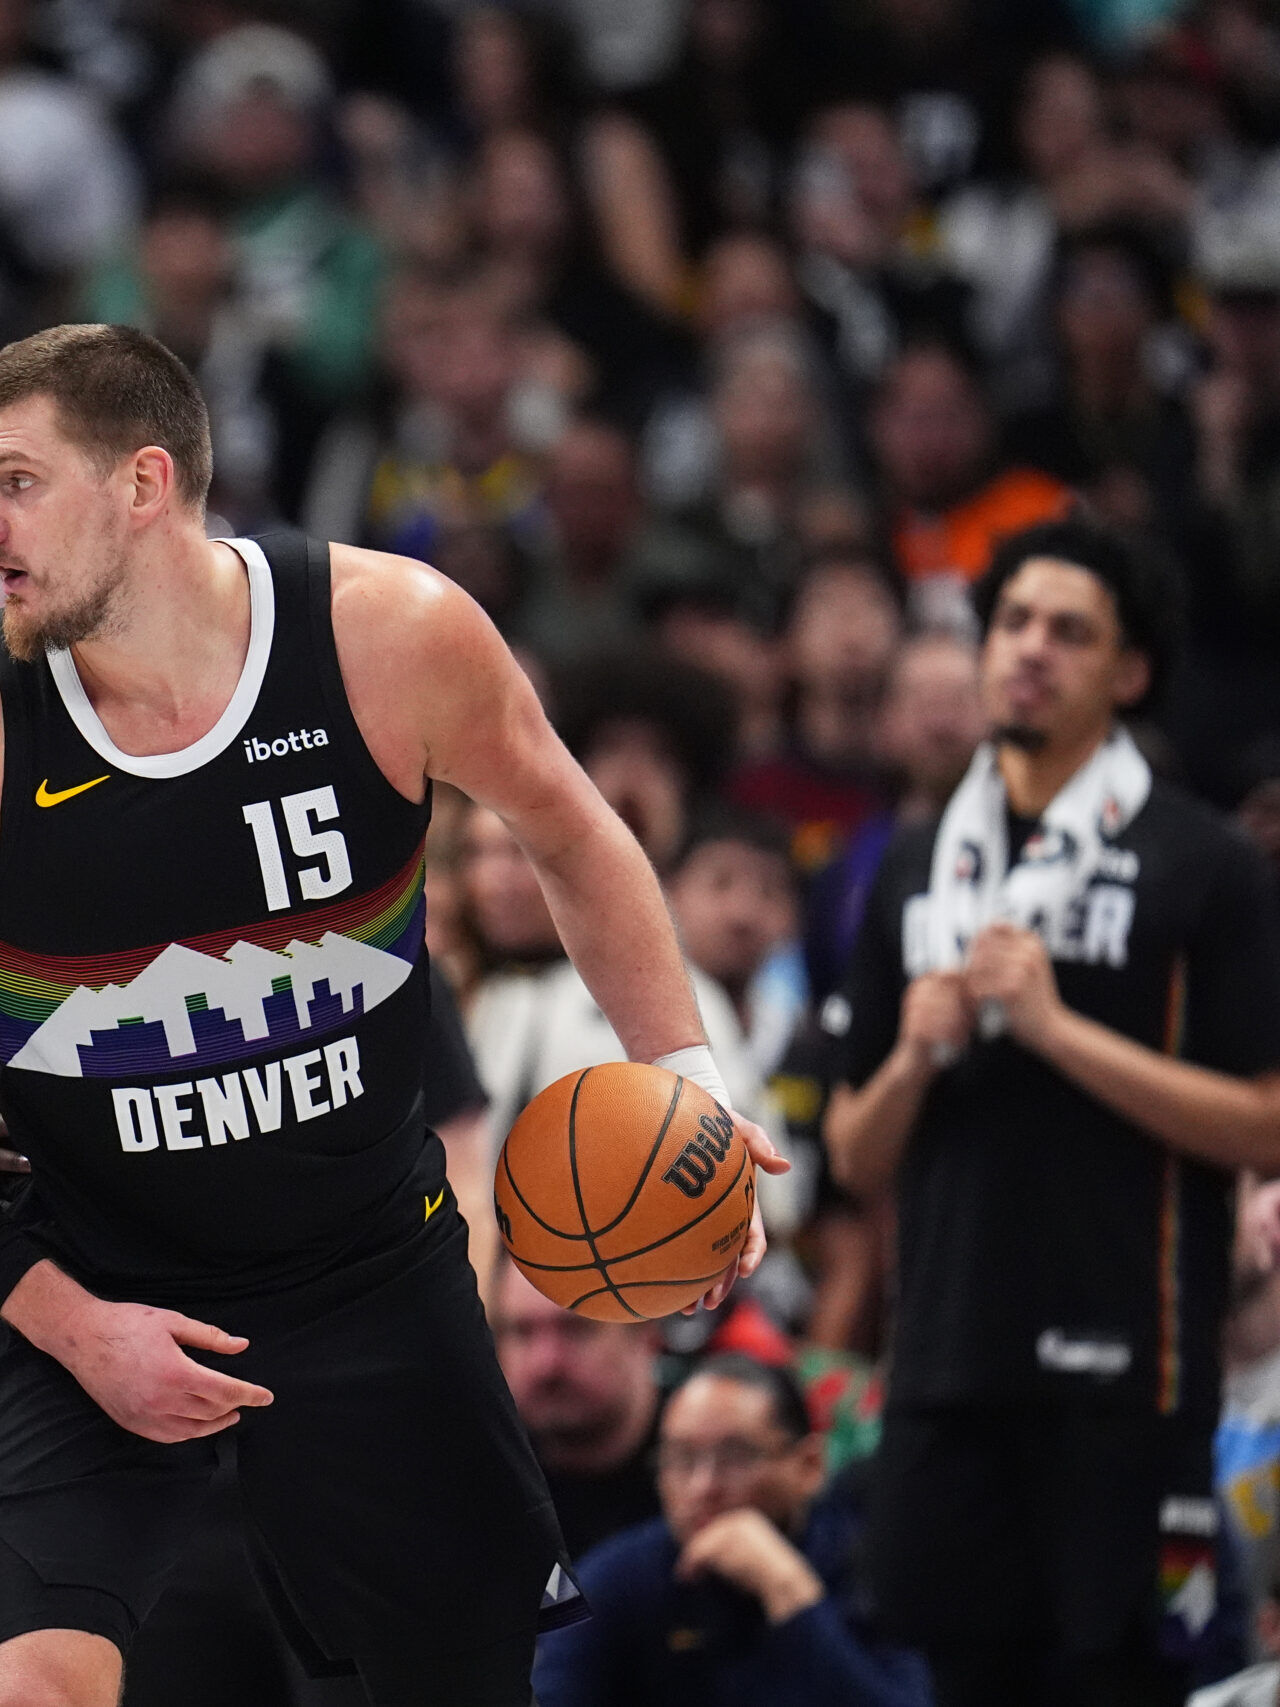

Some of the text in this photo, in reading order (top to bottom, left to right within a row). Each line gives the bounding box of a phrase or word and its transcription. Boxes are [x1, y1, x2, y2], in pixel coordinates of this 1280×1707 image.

[243, 728, 329, 763] ibotta
[242, 785, 353, 912] 15
[111, 1035, 364, 1152] DENVER
